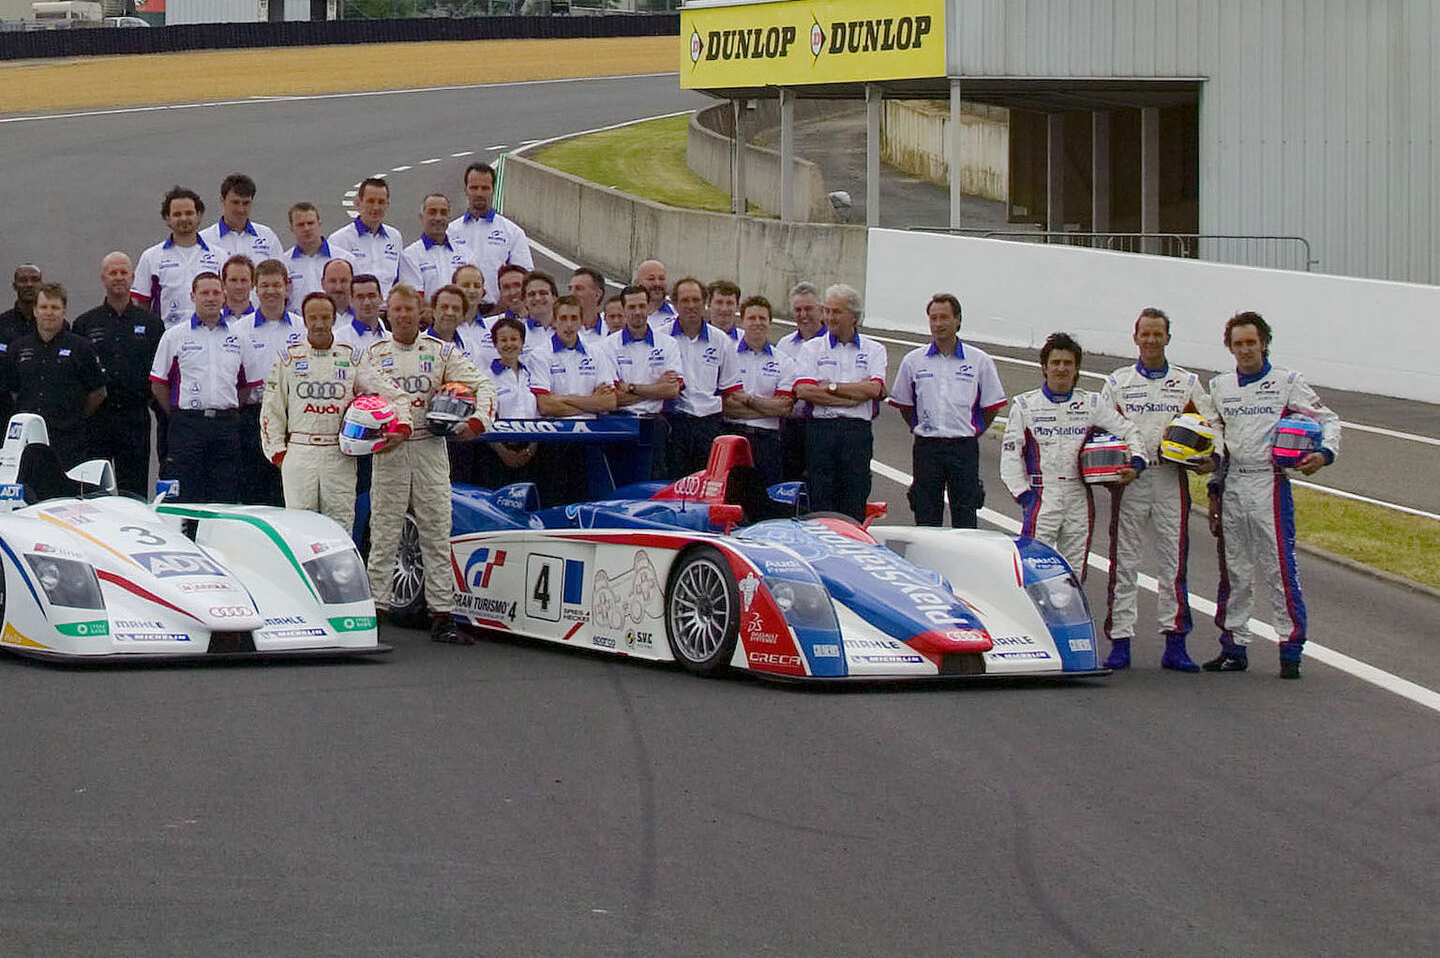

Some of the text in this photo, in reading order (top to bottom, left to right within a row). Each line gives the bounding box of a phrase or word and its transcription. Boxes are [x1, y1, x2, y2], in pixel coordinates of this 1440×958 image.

[828, 16, 932, 54] DUNLOP
[705, 26, 796, 61] DUNLOP
[303, 403, 340, 415] Audi
[1125, 403, 1180, 415] PlayStation
[1223, 405, 1275, 417] PlayStation
[1033, 426, 1087, 438] PlayStation
[0, 486, 22, 497] ADT
[119, 526, 167, 546] 3
[149, 554, 218, 575] ADT
[533, 563, 551, 612] 4
[473, 595, 508, 615] TURISMO
[508, 601, 518, 622] 4
[115, 620, 165, 629] MAHLE
[845, 640, 901, 650] MAHLE
